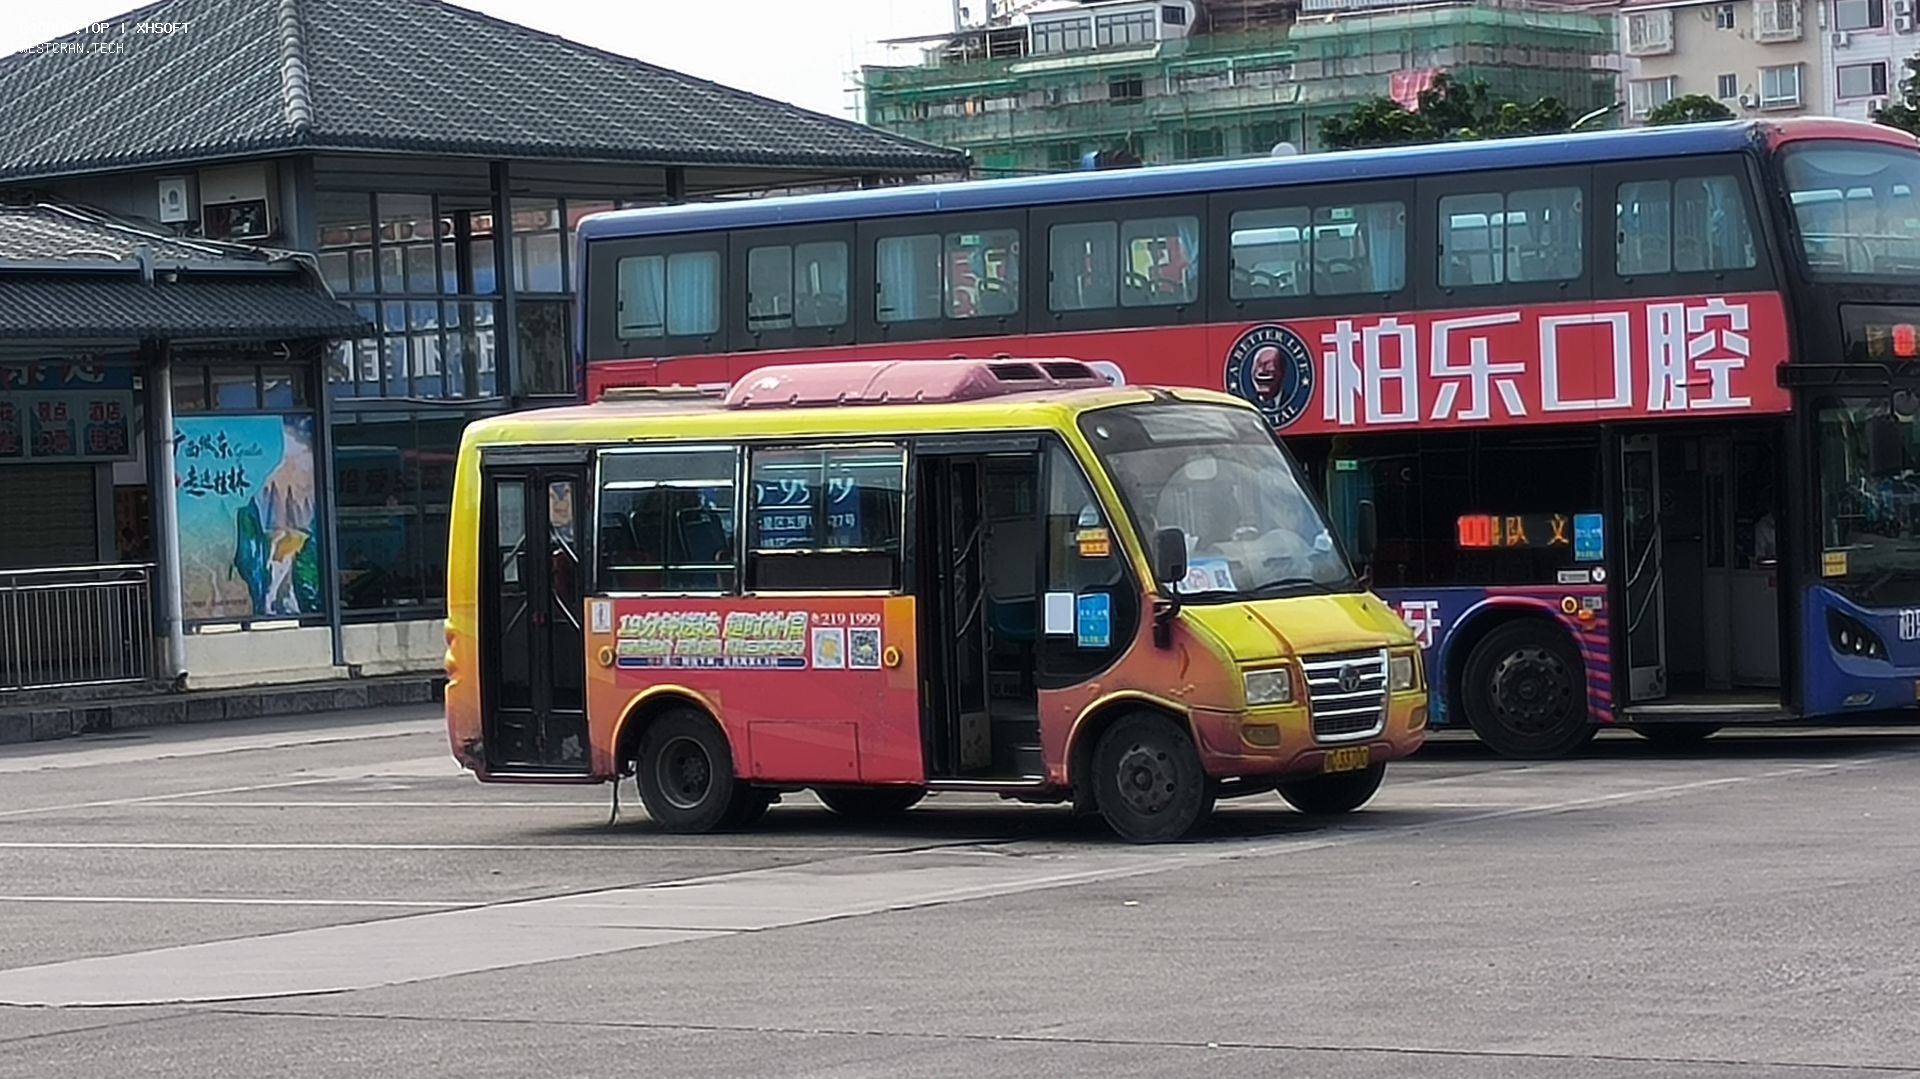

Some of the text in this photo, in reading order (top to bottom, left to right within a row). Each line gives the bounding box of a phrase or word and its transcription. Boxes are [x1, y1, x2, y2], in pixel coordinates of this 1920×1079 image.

[1233, 329, 1284, 360] BETTER
[1286, 338, 1309, 373] LIFE
[1321, 298, 1752, 425] 柏乐口腔
[90, 401, 121, 421] 酒店
[1544, 512, 1570, 546] 文
